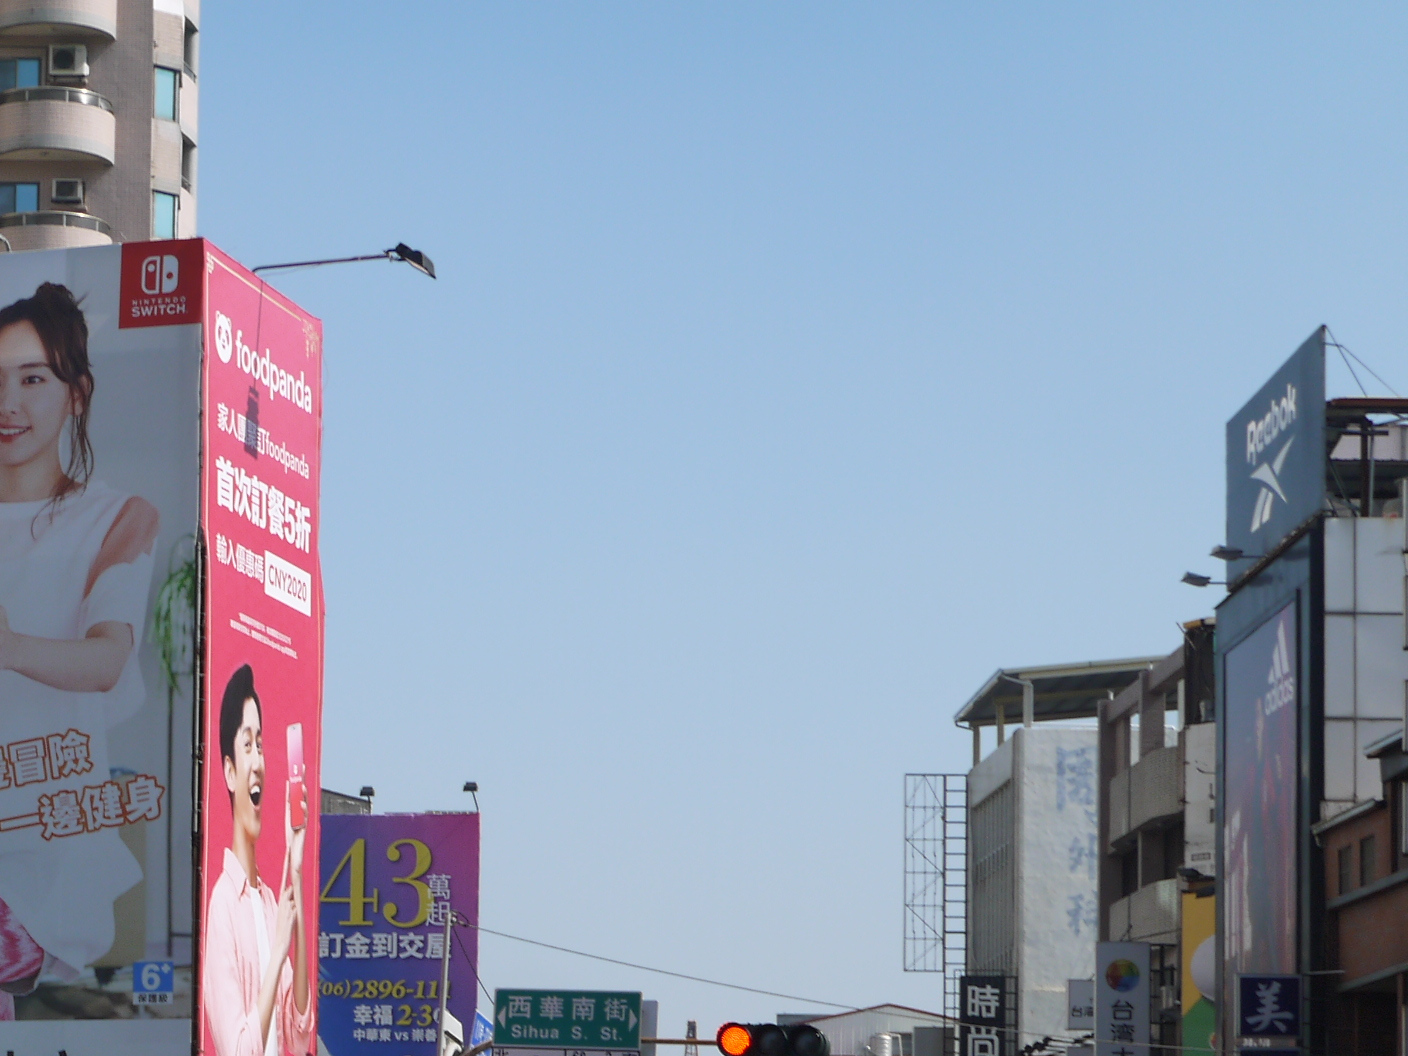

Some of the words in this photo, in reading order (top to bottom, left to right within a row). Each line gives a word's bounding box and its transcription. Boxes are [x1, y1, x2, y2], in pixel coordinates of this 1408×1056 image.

[132, 296, 187, 306] NINTENDO
[132, 303, 187, 318] SWITCH
[235, 329, 313, 415] foodpanda
[1246, 385, 1297, 466] Reebok
[216, 456, 312, 554] 首次訂餐5折
[268, 564, 308, 603] CNY2020
[1265, 673, 1295, 717] adidas
[320, 837, 435, 928] 43
[318, 931, 451, 960] 訂金到交屋
[353, 1004, 393, 1027] 幸福
[508, 995, 628, 1022] 西華南街
[353, 1028, 392, 1042] 中華東
[511, 1024, 560, 1039] Sihua
[571, 1026, 588, 1041] S.
[600, 1026, 623, 1042] St.
